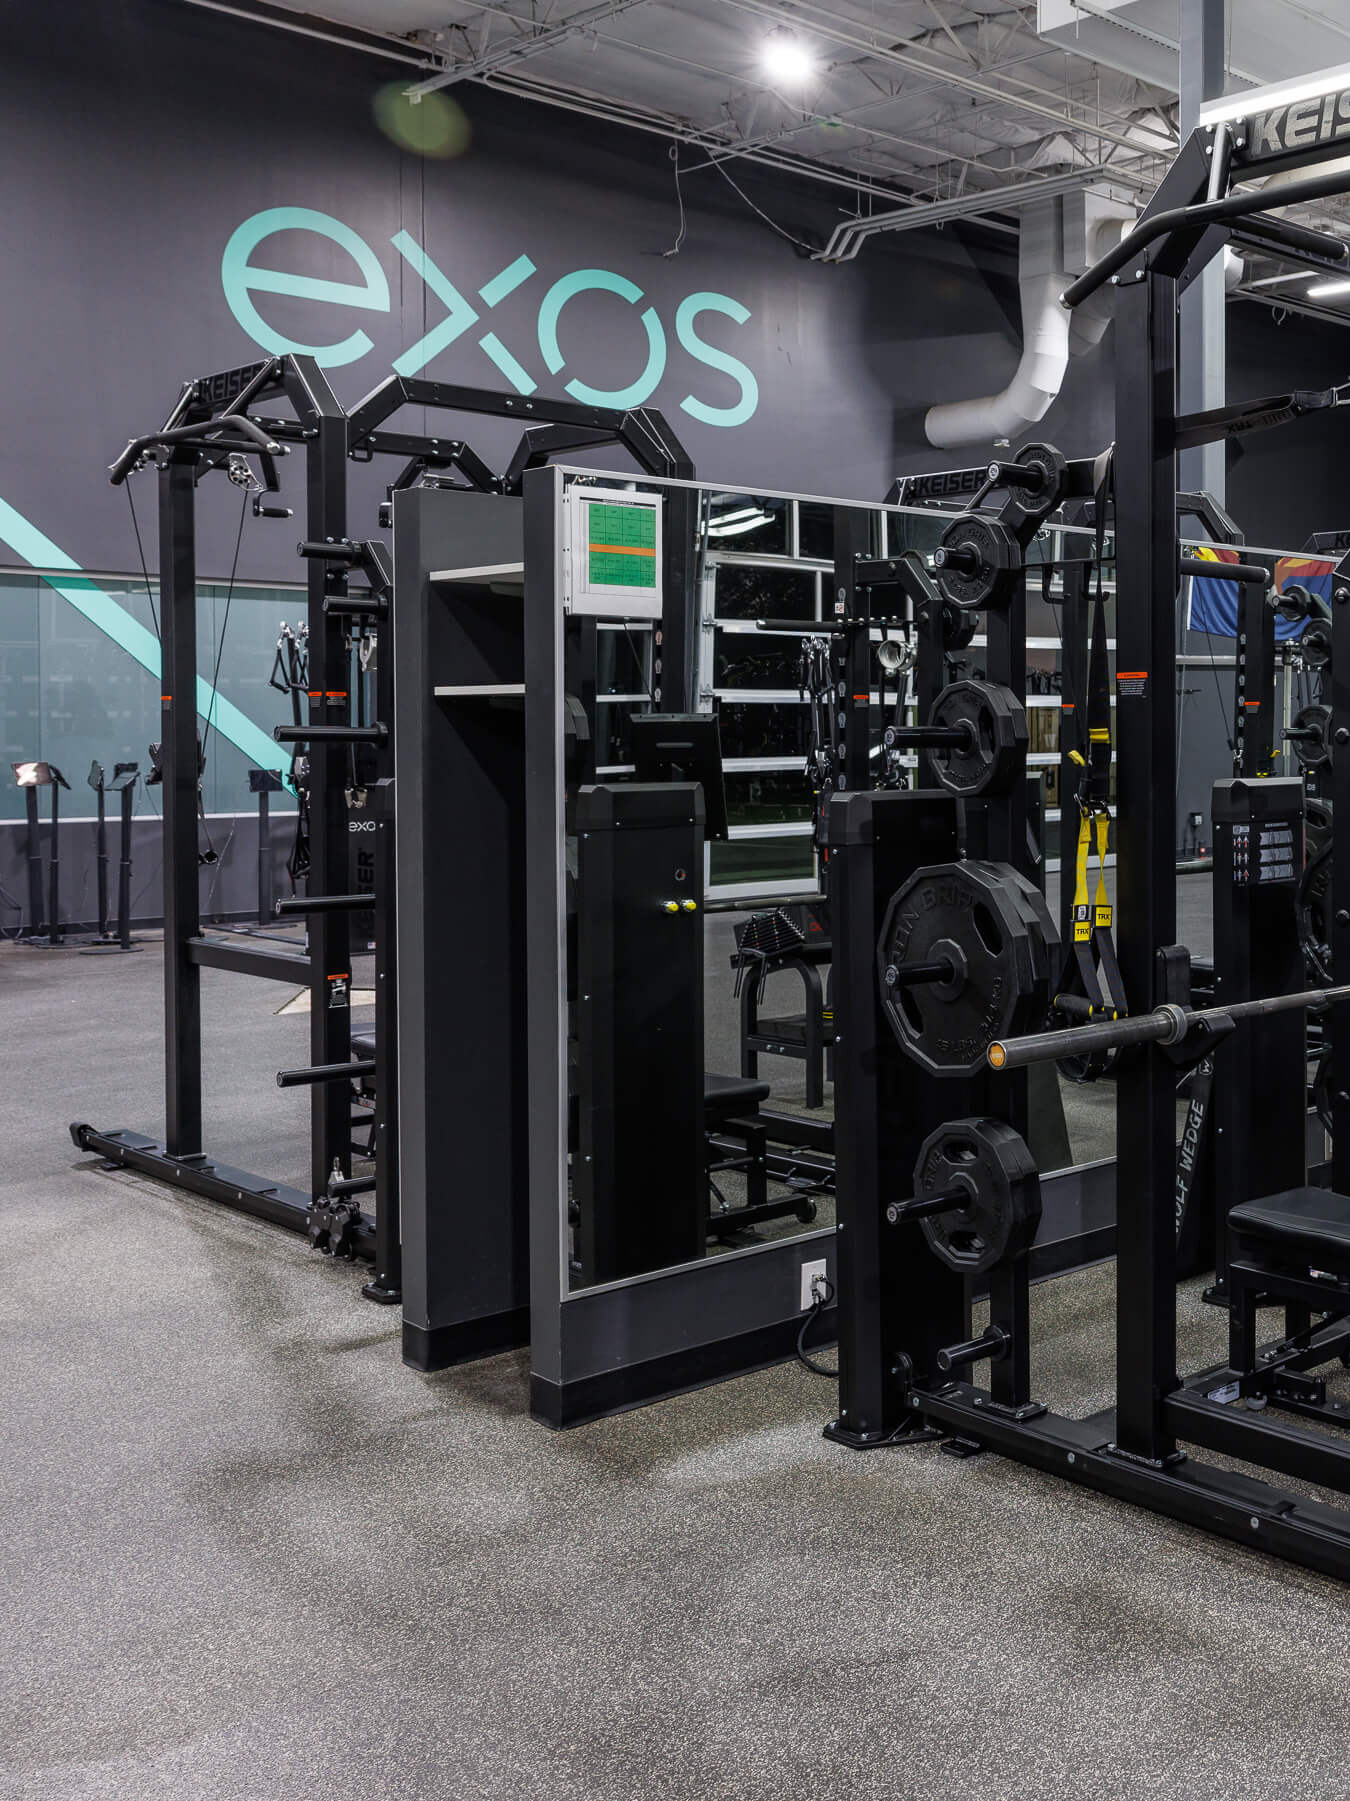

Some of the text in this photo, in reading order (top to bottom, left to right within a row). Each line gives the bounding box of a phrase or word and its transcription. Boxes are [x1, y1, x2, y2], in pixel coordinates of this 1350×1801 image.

[221, 205, 760, 428] exos
[348, 820, 376, 833] exo
[1097, 913, 1110, 921] TRX
[1076, 928, 1089, 936] TRX
[1176, 1098, 1205, 1234] OLF WEDGE
